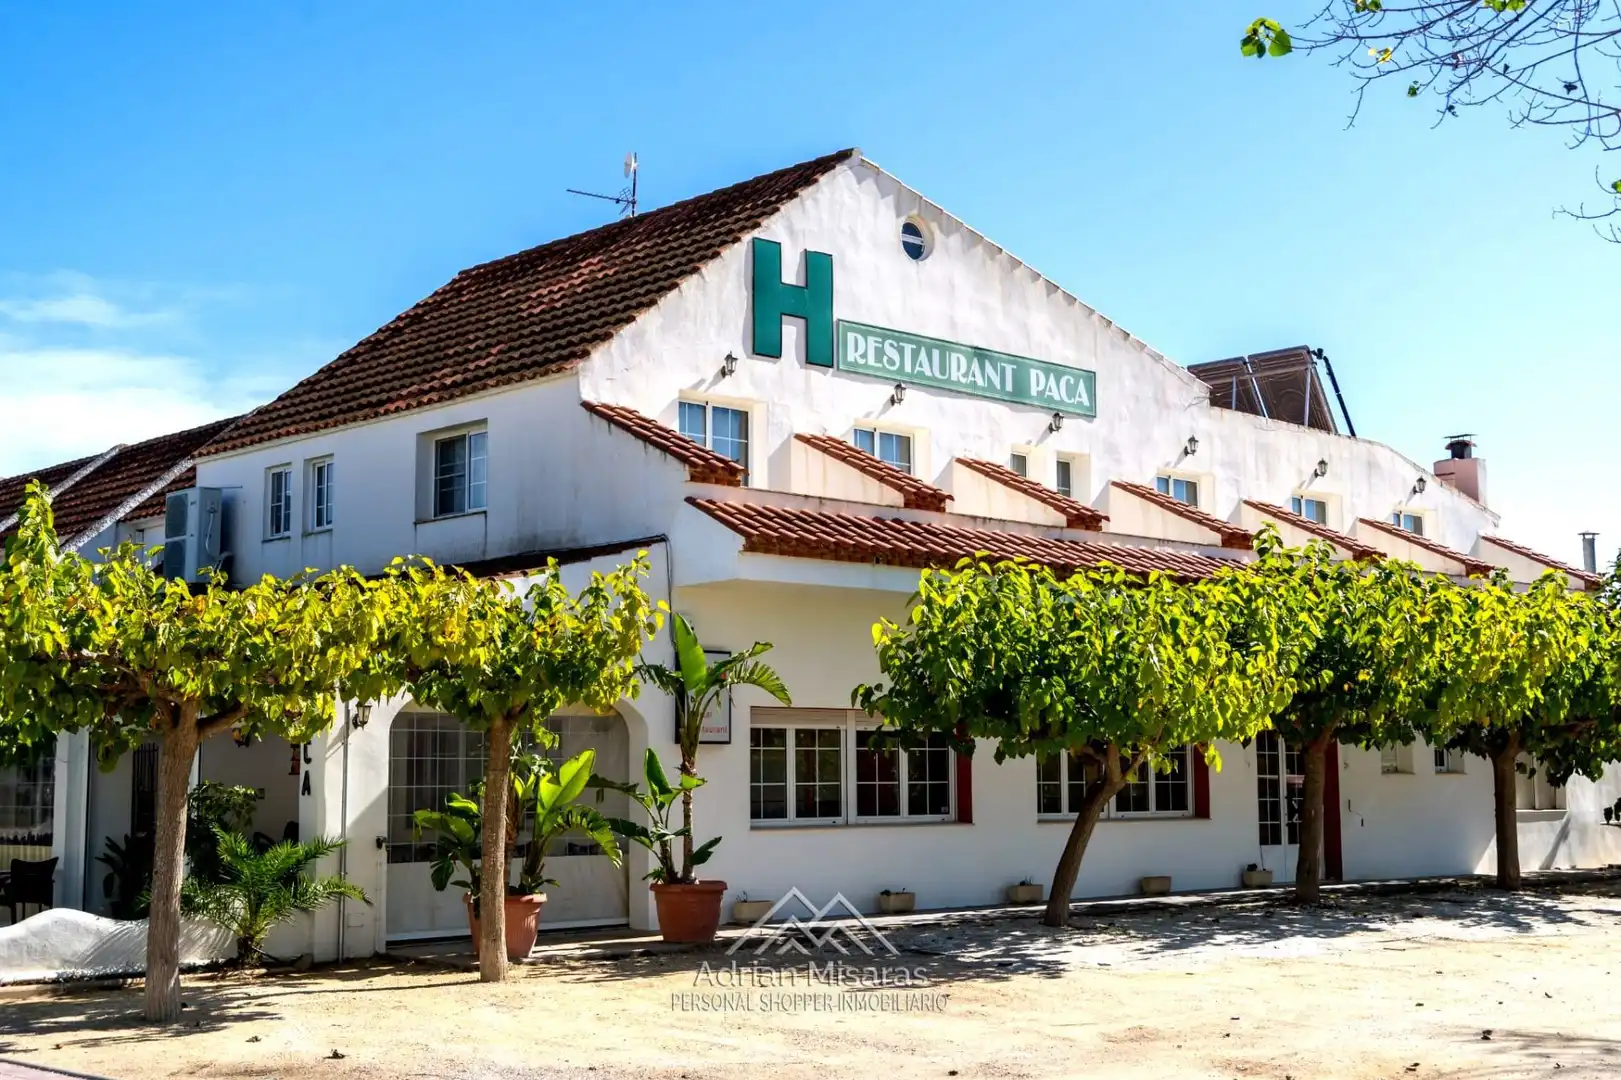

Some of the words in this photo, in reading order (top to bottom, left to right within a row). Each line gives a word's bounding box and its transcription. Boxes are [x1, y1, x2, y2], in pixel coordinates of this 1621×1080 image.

[752, 237, 834, 367] H
[846, 331, 1017, 393] RESTAURANT
[1029, 367, 1091, 407] PACA
